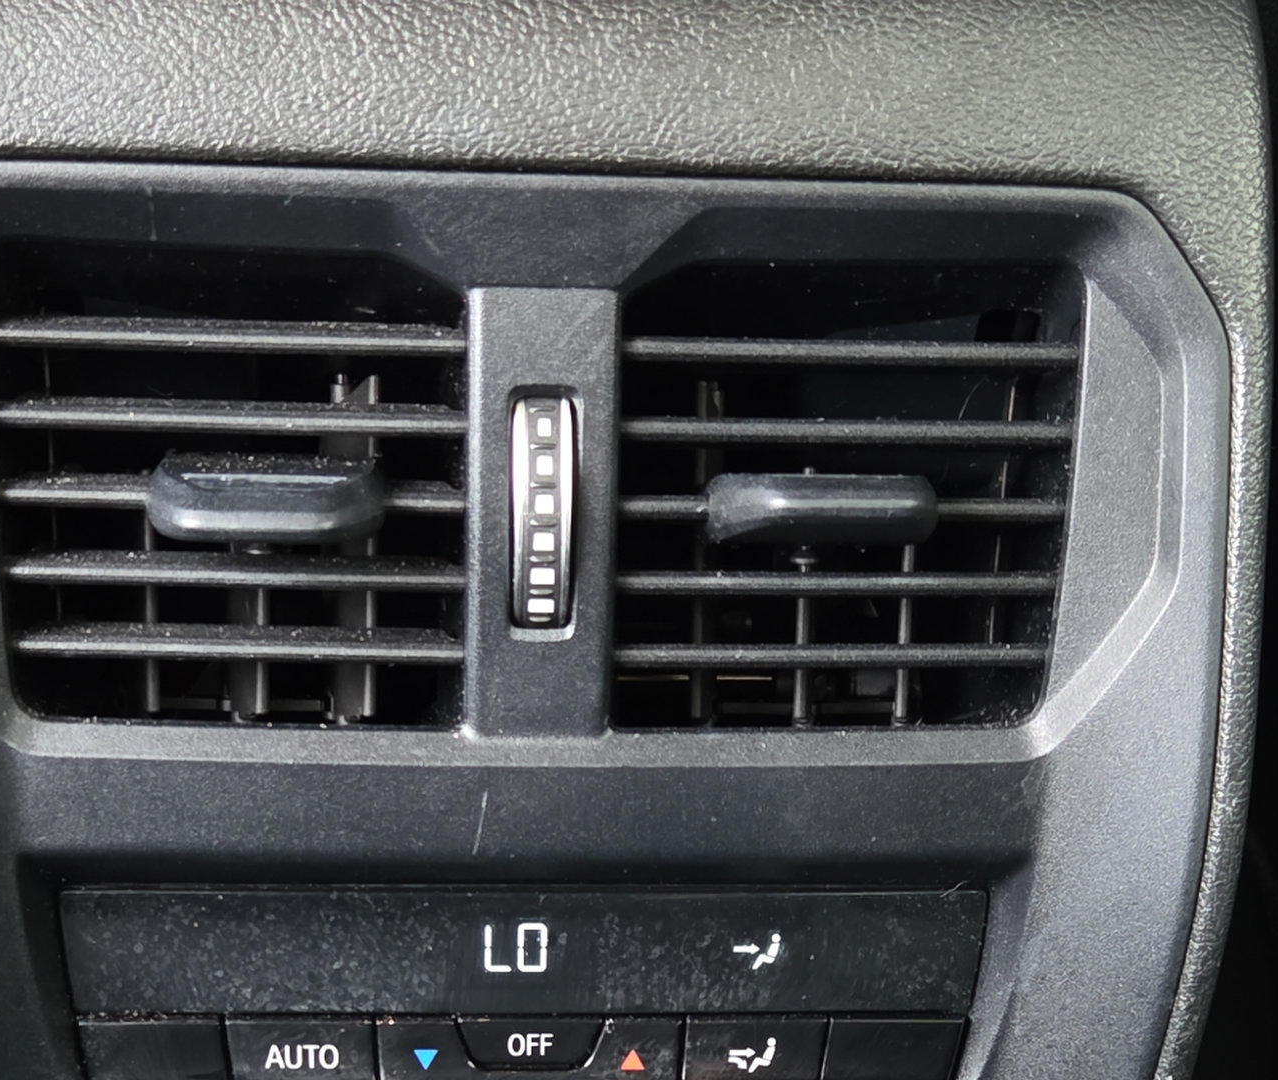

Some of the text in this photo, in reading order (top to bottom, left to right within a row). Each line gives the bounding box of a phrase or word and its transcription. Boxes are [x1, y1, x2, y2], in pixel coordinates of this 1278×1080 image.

[483, 922, 549, 973] LO
[264, 1043, 340, 1070] AUTO
[507, 1032, 554, 1057] OFF
